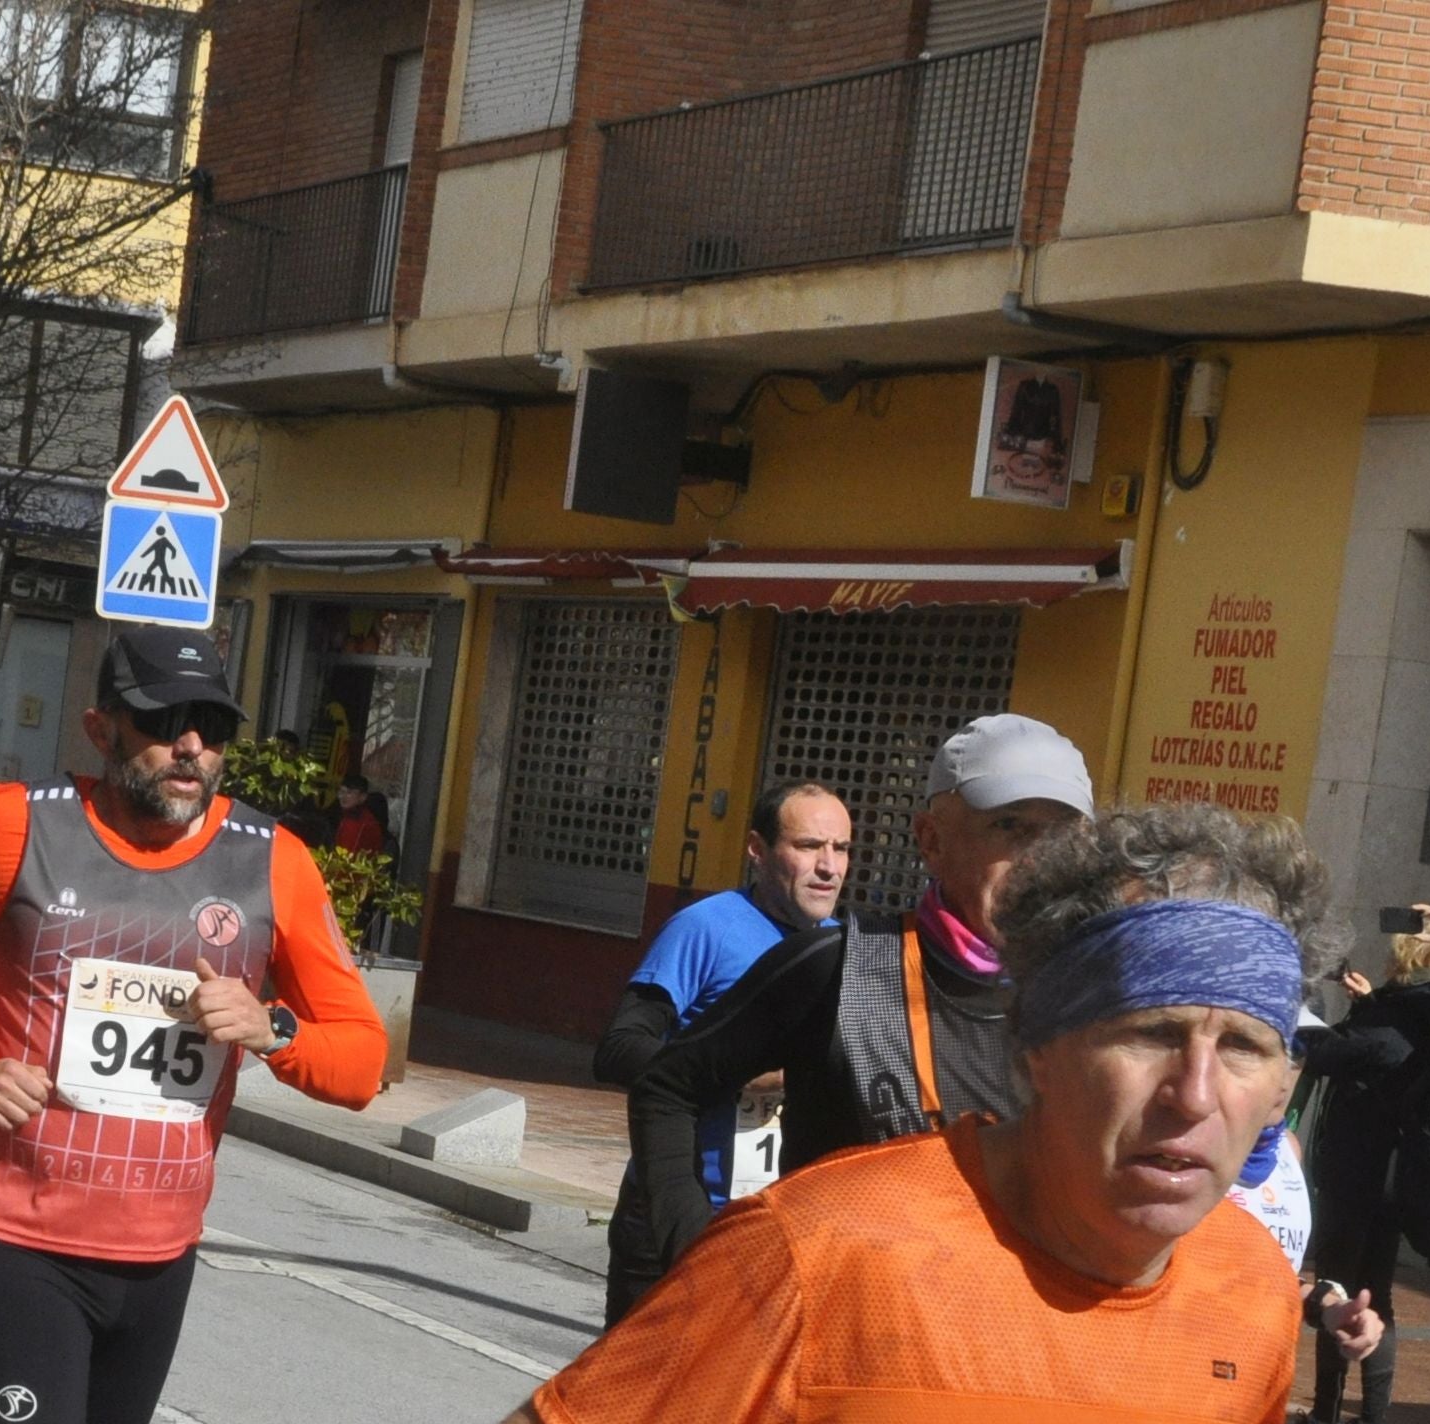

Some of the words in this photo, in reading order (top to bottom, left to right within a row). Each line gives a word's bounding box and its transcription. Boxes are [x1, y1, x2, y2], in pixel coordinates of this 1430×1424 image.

[1208, 593, 1272, 622] Artículos
[1193, 628, 1277, 659] FUMADOR
[1210, 665, 1248, 695] PIEL
[1190, 700, 1257, 731] REGALO
[1151, 733, 1225, 768] LOTERÍAS
[1216, 777, 1280, 813] MÓVILES
[109, 977, 186, 1009] FOND
[150, 973, 194, 989] PREMIO
[89, 1019, 208, 1087] 945
